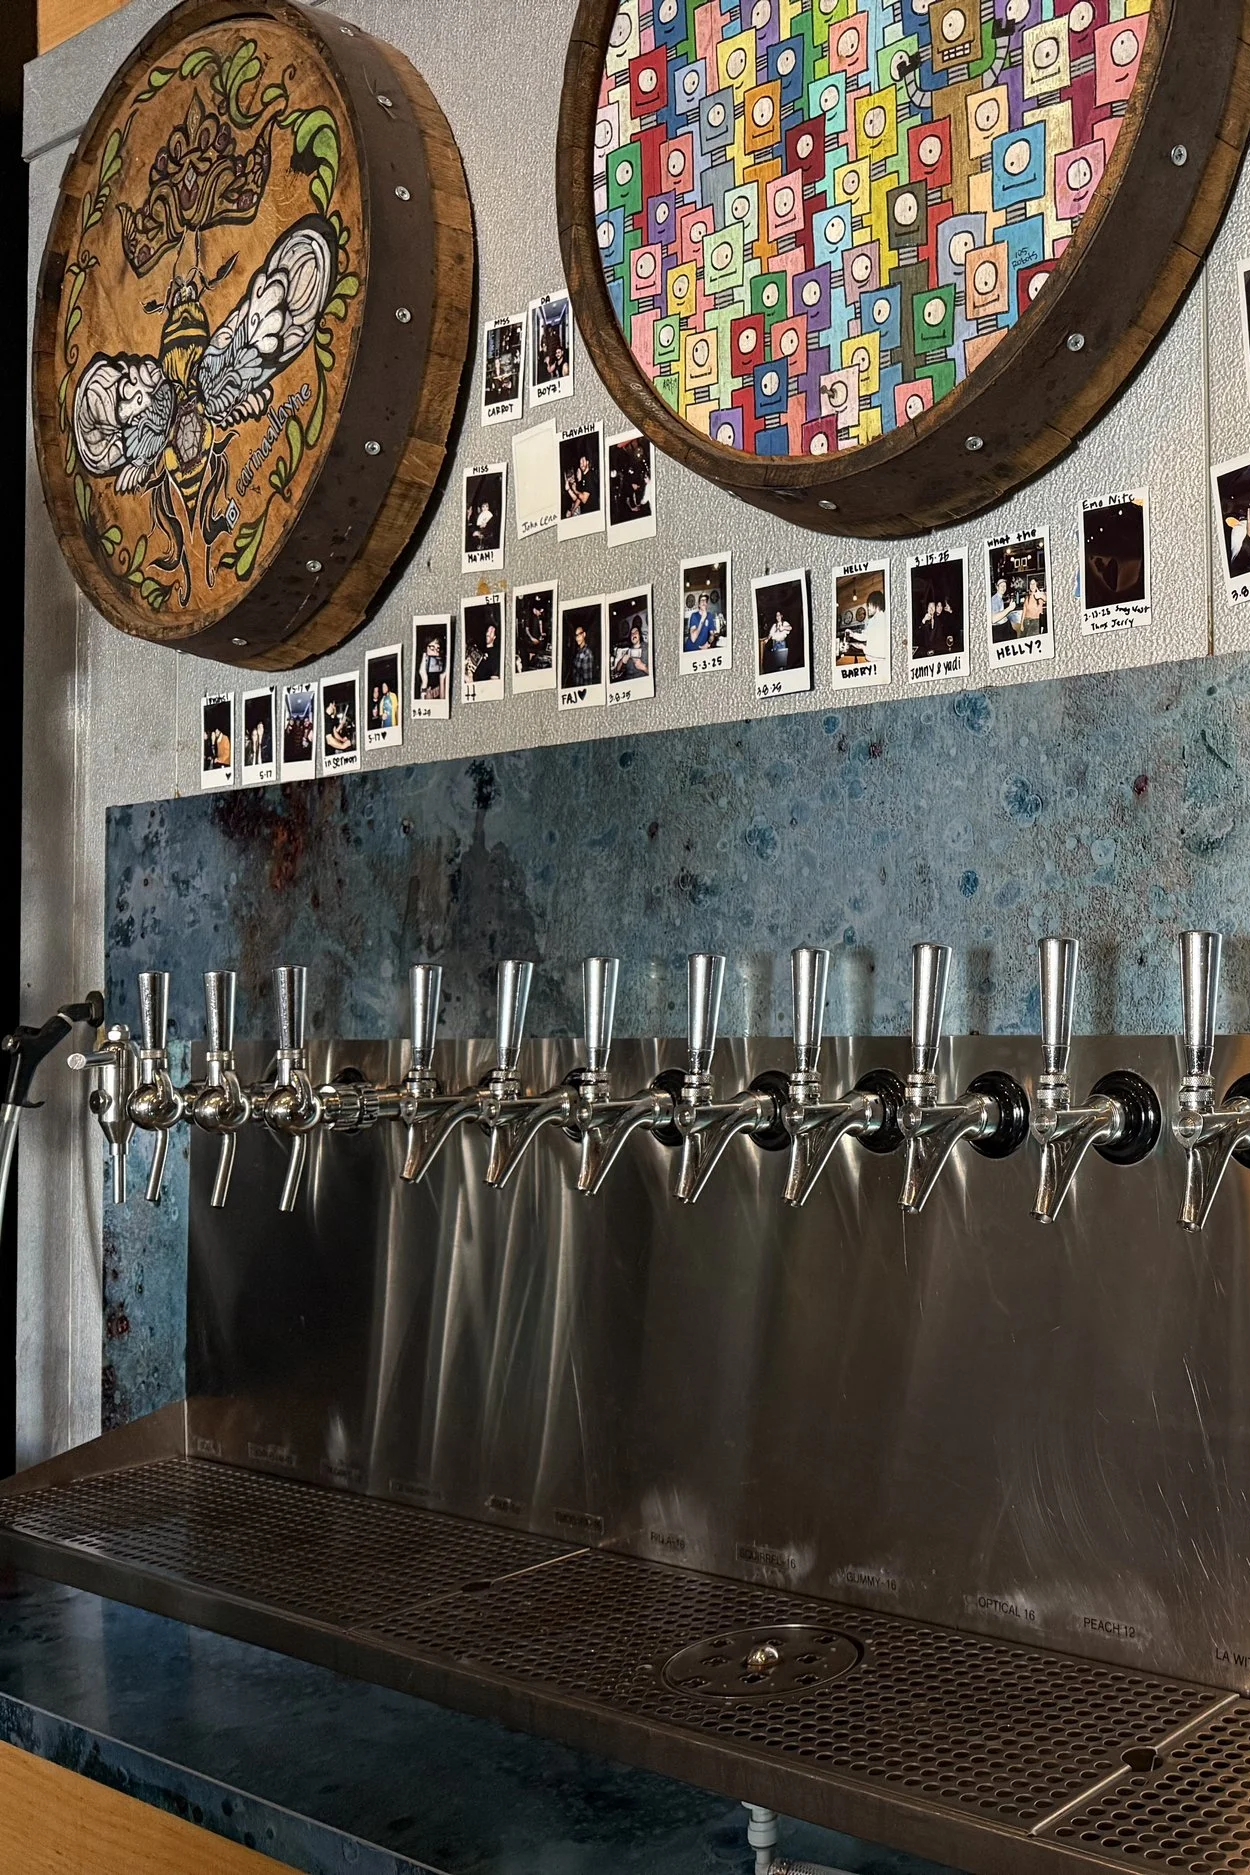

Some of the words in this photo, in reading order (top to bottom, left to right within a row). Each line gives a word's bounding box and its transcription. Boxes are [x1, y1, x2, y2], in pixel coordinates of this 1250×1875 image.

[493, 317, 511, 327] MISS
[487, 403, 515, 418] CARROT
[472, 464, 490, 475] MISS
[1082, 499, 1103, 510] Emo
[1016, 528, 1037, 542] the
[843, 562, 869, 574] HELLY
[996, 639, 1042, 661] HELLY?
[841, 663, 877, 679] BARRY!
[846, 1571, 897, 1591] GUMMY-16
[977, 1596, 1022, 1618] OPTICAL
[1023, 1609, 1036, 1621] 16
[1083, 1616, 1121, 1636] PEACH
[1215, 1648, 1232, 1661] LA
